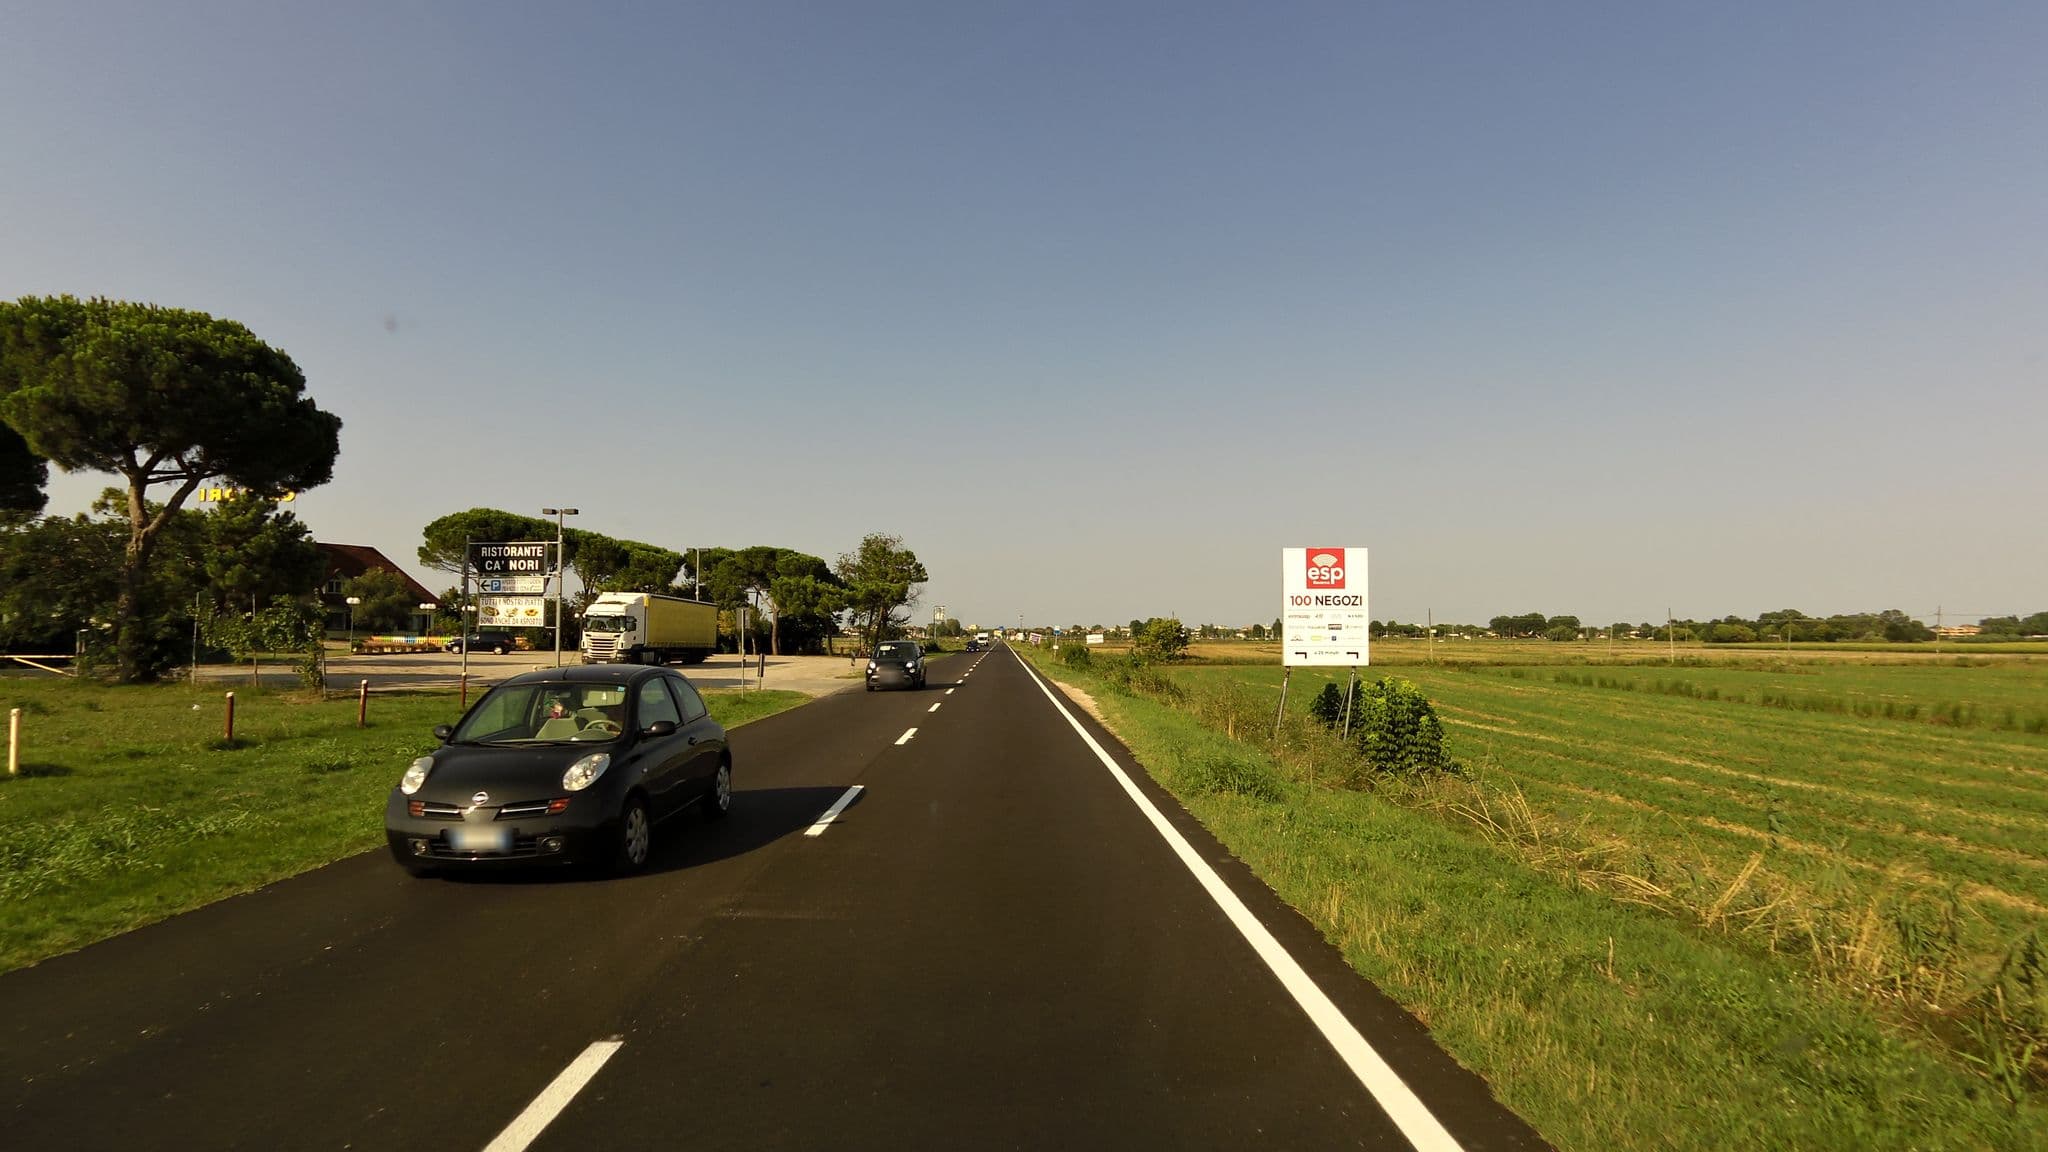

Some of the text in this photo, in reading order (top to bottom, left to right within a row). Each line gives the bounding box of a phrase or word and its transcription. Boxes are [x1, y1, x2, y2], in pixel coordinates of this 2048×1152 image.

[481, 546, 543, 557] RISTORANTE
[485, 560, 539, 571] CA' NORI
[1308, 567, 1344, 585] esp
[492, 580, 500, 591] P
[1290, 595, 1363, 606] 100 NEGOZI
